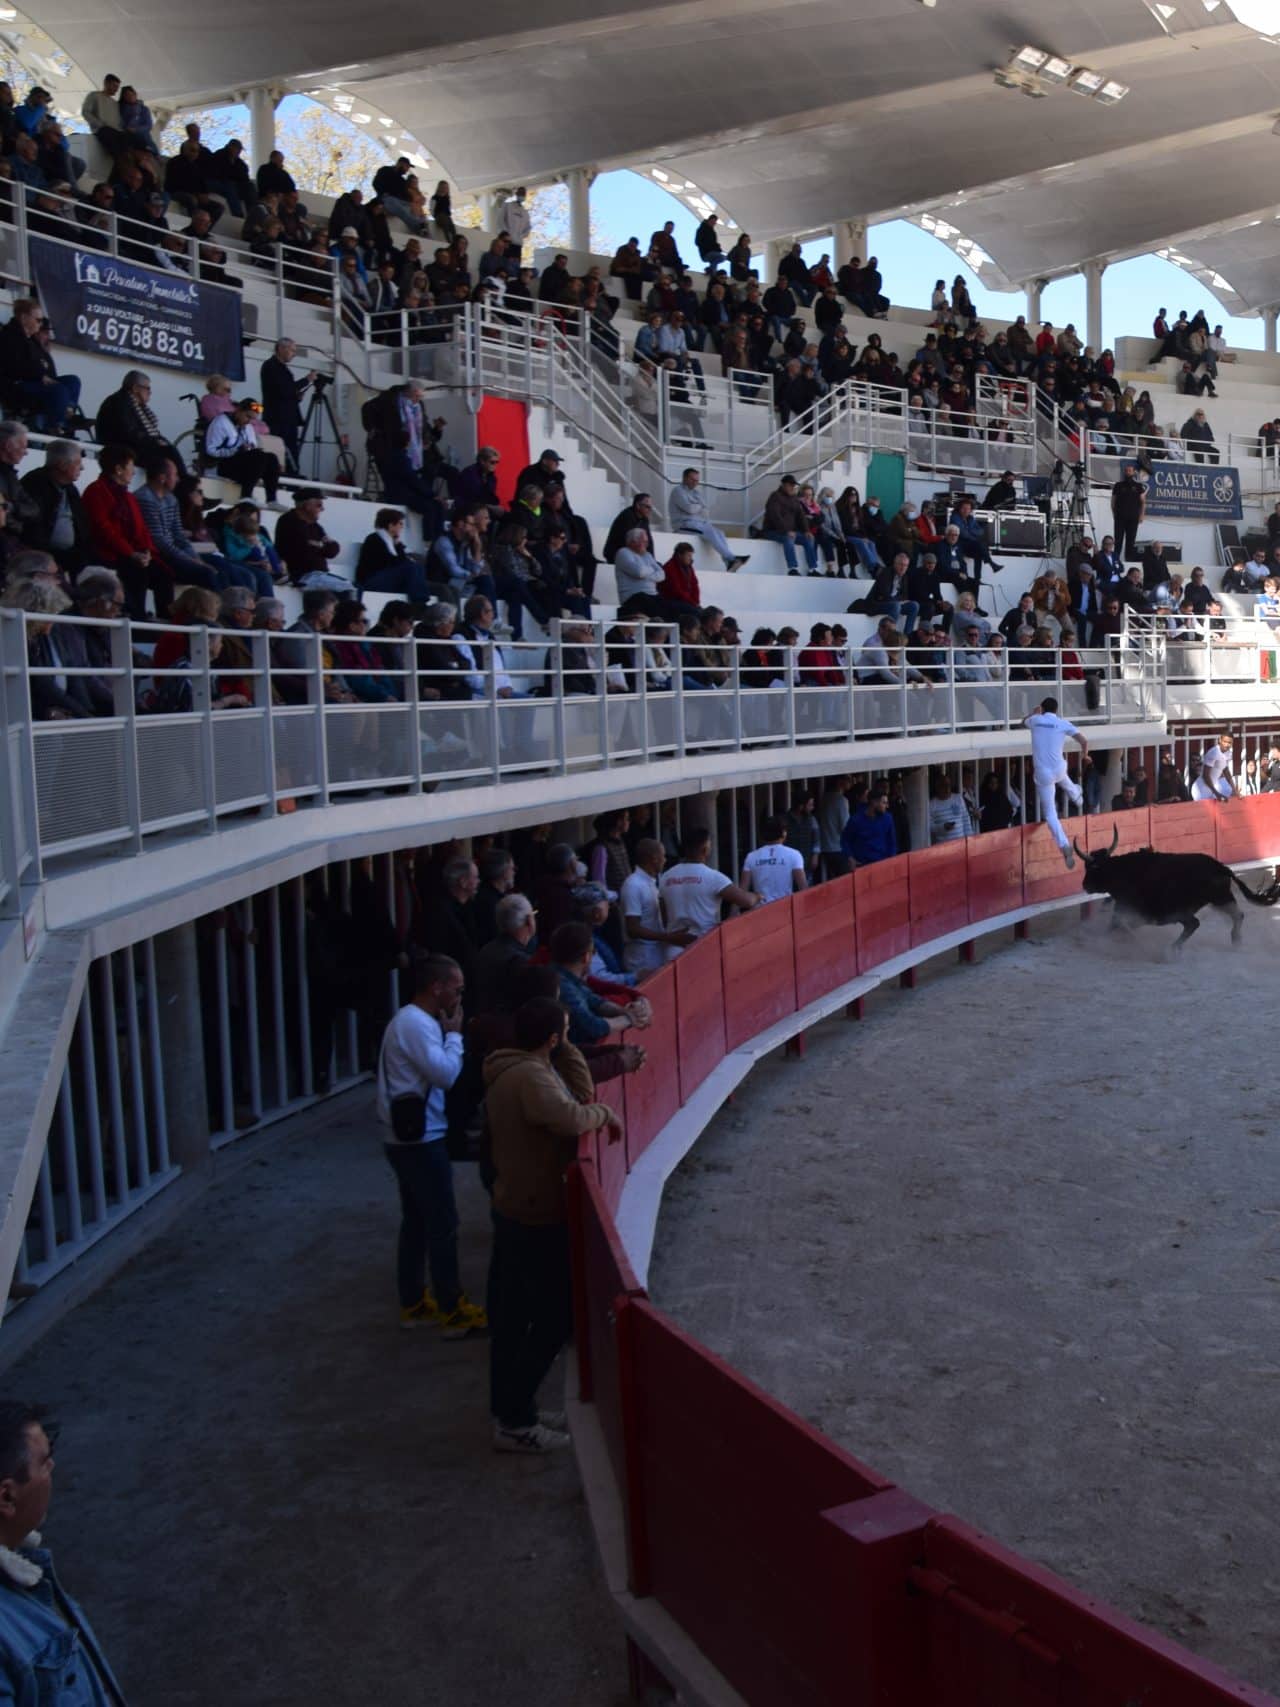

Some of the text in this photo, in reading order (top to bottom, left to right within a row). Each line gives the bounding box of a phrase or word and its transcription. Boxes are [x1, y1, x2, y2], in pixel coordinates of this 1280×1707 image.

[77, 314, 101, 341] 04
[106, 317, 130, 346] 67
[132, 323, 152, 350] 68
[156, 330, 179, 356] 82
[182, 338, 205, 361] 01
[1154, 471, 1208, 489] CALVET
[1156, 487, 1208, 500] IMMOBILIER
